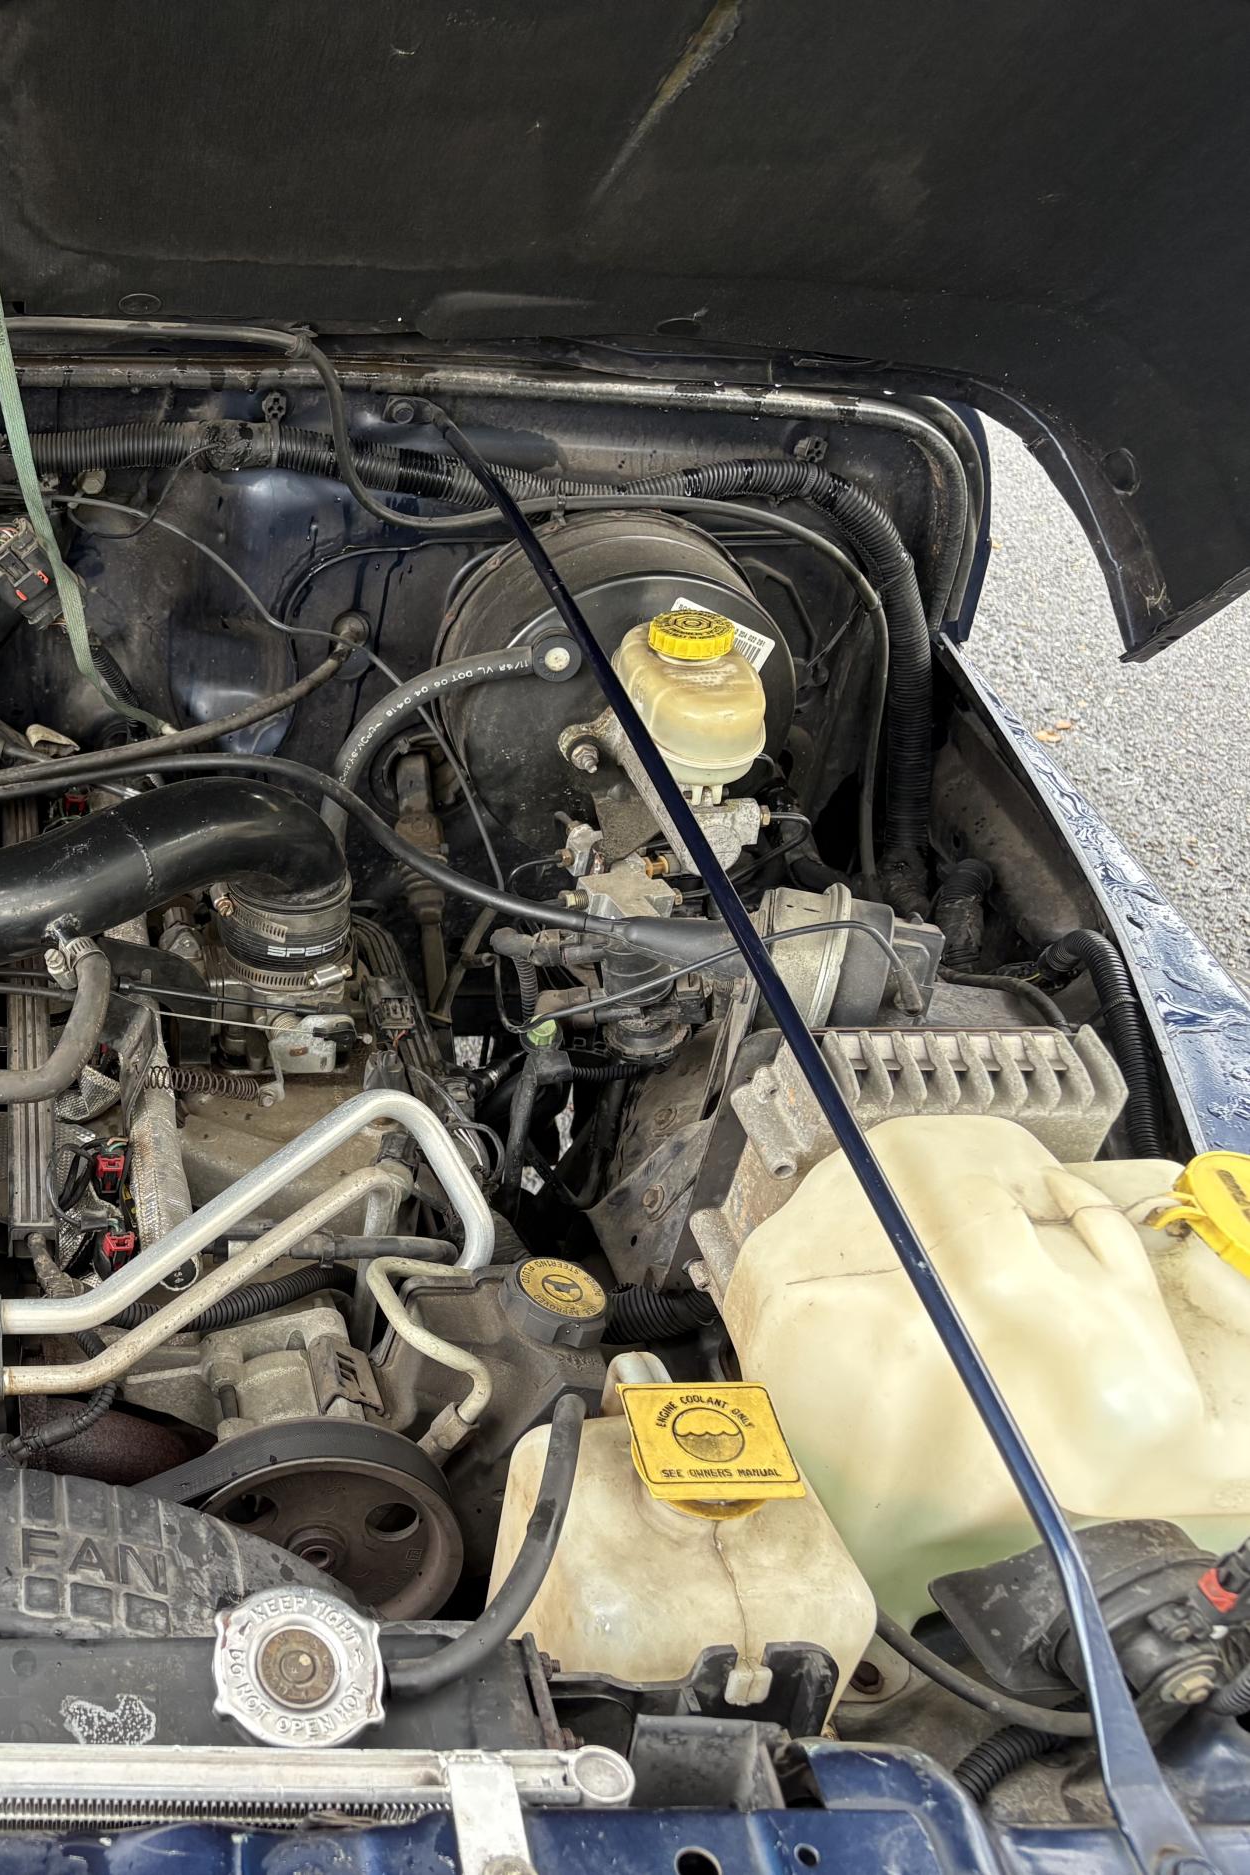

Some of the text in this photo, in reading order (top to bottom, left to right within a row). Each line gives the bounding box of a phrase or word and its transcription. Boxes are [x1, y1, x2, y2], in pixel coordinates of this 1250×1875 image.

[451, 670, 473, 683] DOT
[413, 686, 429, 697] 04
[521, 1264, 535, 1284] FLUID
[535, 1260, 581, 1275] STEERING
[655, 1394, 756, 1430] ENGINE COOLANT ONLY
[661, 1468, 782, 1478] SEE OWNERS MANUAL
[21, 1526, 170, 1596] FAN
[250, 1596, 362, 1646] KEEP TIGHT
[229, 1649, 366, 1738] DO NOT OPEN HOT
